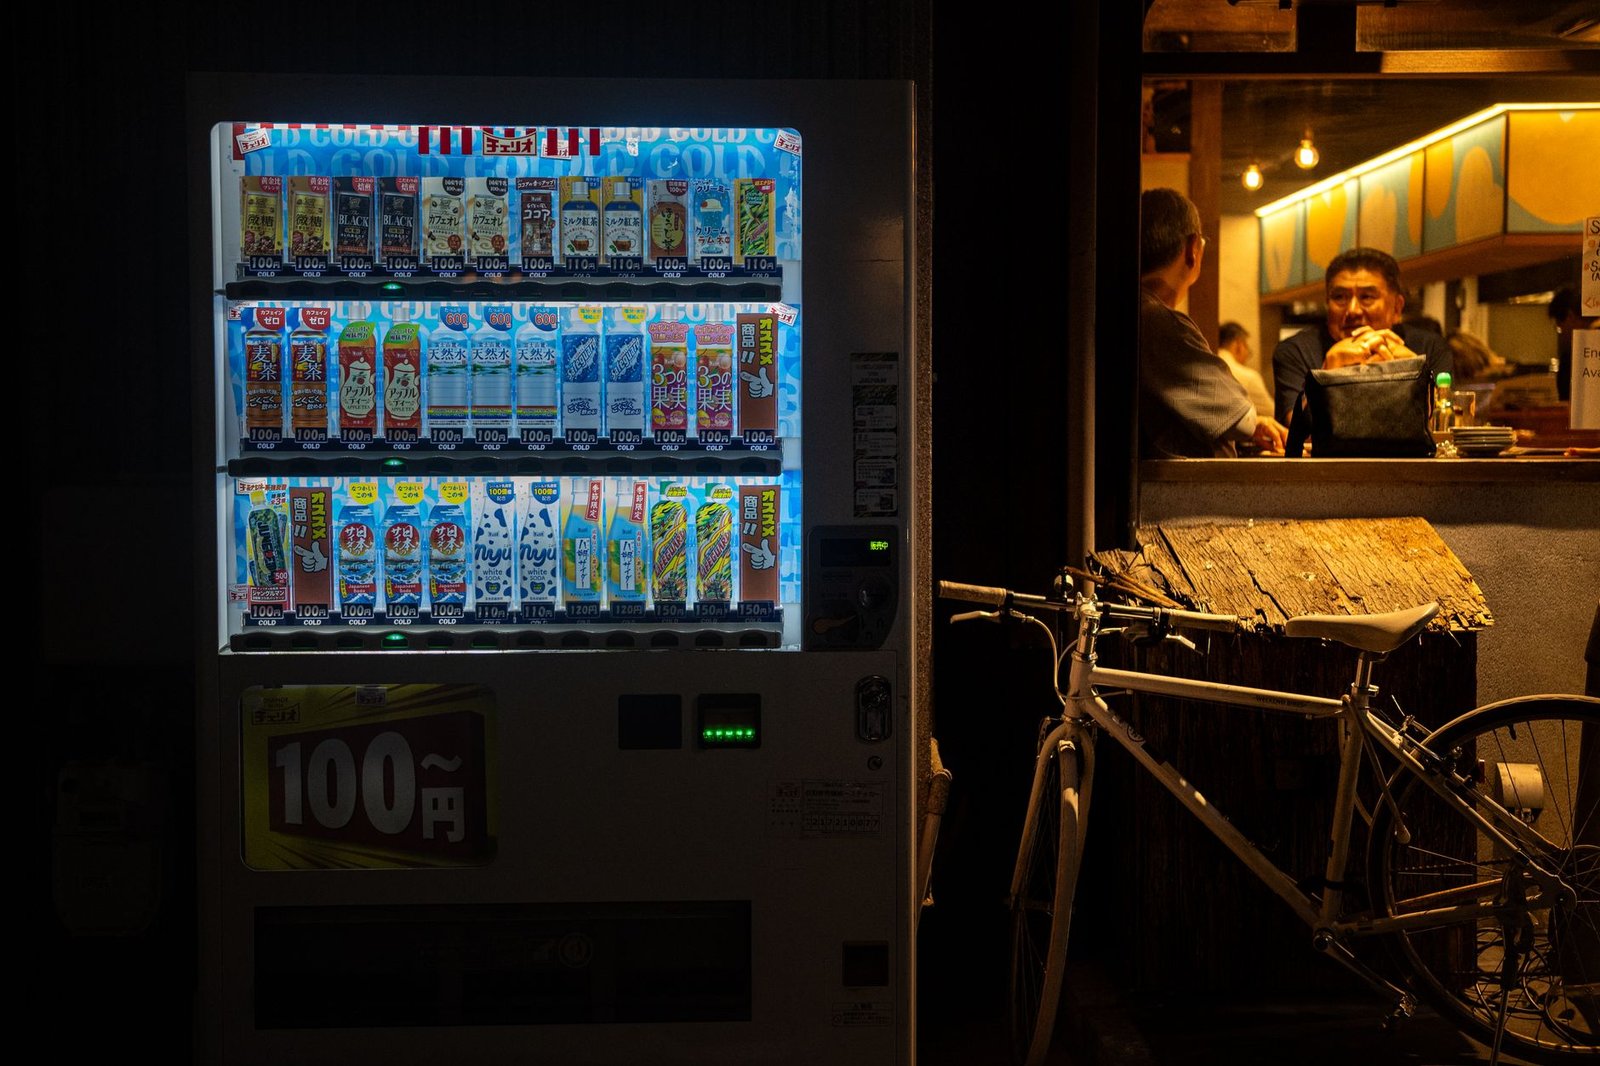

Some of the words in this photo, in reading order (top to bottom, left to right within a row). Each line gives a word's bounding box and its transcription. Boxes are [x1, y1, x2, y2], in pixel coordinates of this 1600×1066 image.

[242, 138, 266, 150] チェリオ
[486, 137, 533, 153] チェリオ
[248, 214, 274, 226] 微糖
[296, 214, 322, 226] 微糖
[339, 214, 369, 227] BLACK
[384, 214, 413, 227] BLACK
[429, 214, 459, 226] カフェオレ
[473, 214, 503, 226] カフェオレ
[523, 210, 551, 221] ココア
[563, 217, 598, 227] ミルク紅茶
[605, 217, 640, 227] ミルク紅茶
[695, 227, 728, 235] クリーム
[251, 257, 280, 269] 100円
[298, 257, 326, 269] 100円
[343, 257, 371, 269] 100円
[388, 257, 417, 269] 100円
[433, 258, 462, 269] 100円
[479, 258, 507, 269] 100円
[524, 258, 552, 269] 100円
[568, 258, 595, 270] 110円
[612, 258, 640, 270] 110円
[658, 258, 686, 270] 100円
[703, 258, 730, 270] 100円
[747, 258, 774, 270] 110円
[446, 314, 468, 325] 600
[490, 314, 511, 325] 600
[534, 314, 556, 325] 600
[759, 318, 773, 366] オススメ
[430, 349, 466, 360] 天然水
[473, 349, 509, 360] 天然水
[519, 349, 555, 360] 天然水
[253, 346, 277, 380] 麦茶
[298, 346, 322, 380] 麦茶
[652, 363, 686, 386] 3つの
[697, 366, 732, 388] 3つの
[345, 387, 373, 396] アップル
[390, 388, 417, 398] アップル
[249, 396, 274, 407] ごくごく
[295, 396, 320, 407] ごくごく
[652, 386, 686, 409] 果実
[697, 388, 731, 410] 果実
[251, 429, 280, 440] 100円
[297, 430, 325, 440] 100円
[343, 430, 371, 441] 100円
[388, 430, 416, 441] 100円
[433, 430, 461, 441] 100円
[478, 430, 506, 441] 100円
[523, 430, 550, 442] 100円
[568, 431, 595, 442] 100円
[612, 431, 640, 442] 100円
[657, 431, 684, 442] 100円
[701, 431, 728, 442] 100円
[746, 432, 773, 442] 100円
[311, 492, 326, 540] オススメ
[761, 490, 775, 537] オススメ
[345, 526, 355, 554] サイダー
[355, 525, 370, 555] 日本の
[391, 526, 401, 554] サイダー
[401, 525, 416, 555] 日本の
[435, 526, 446, 554] サイダー
[446, 525, 460, 555] 日本の
[253, 606, 281, 617] 100円
[298, 606, 326, 617] 100円
[343, 605, 371, 616] 100円
[389, 605, 416, 616] 100円
[433, 605, 461, 616] 100円
